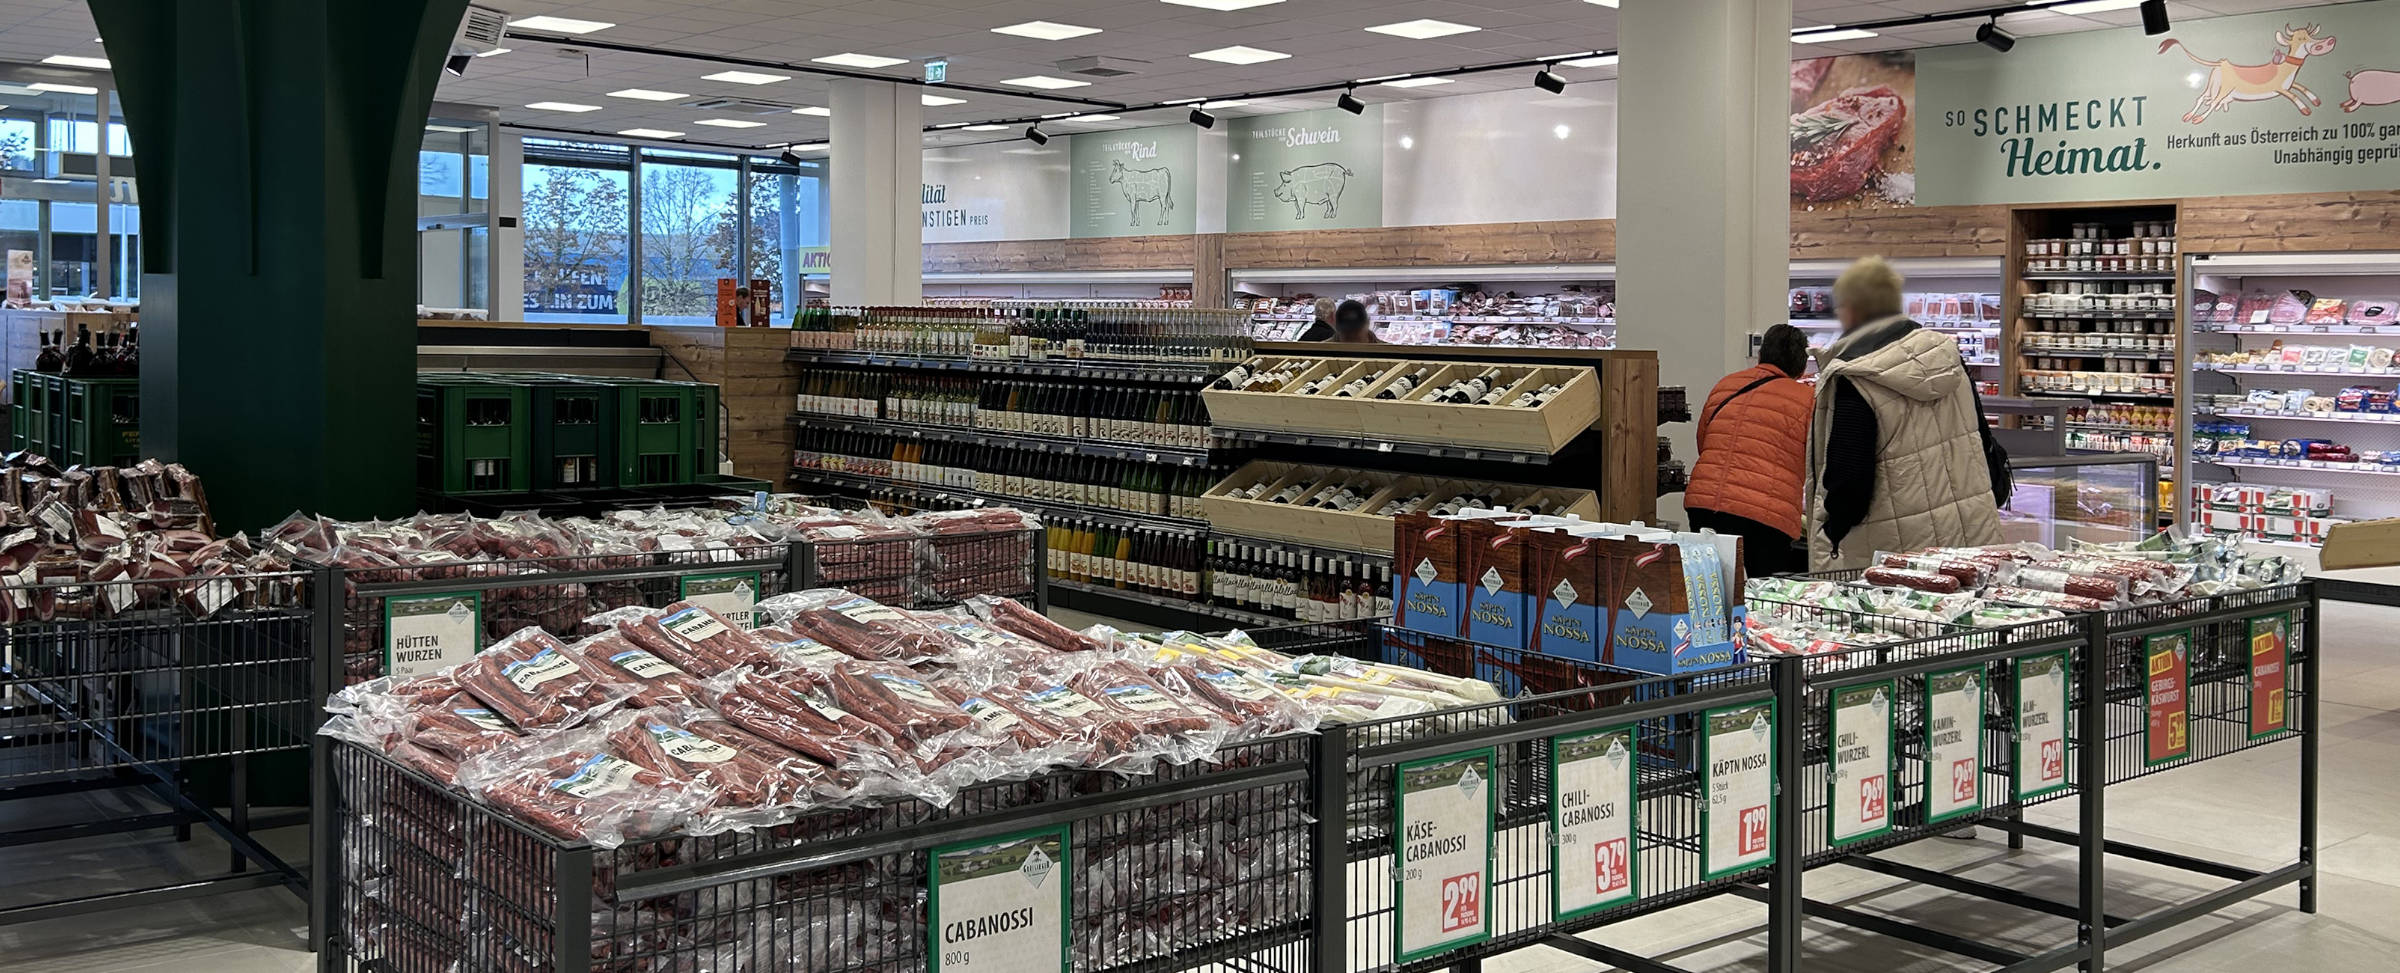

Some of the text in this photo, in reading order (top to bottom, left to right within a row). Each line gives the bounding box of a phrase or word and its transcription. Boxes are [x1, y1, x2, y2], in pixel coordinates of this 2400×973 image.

[1945, 96, 2148, 137] SO SCHMECKT
[1286, 126, 1341, 147] Schwein
[2167, 134, 2221, 149] Herkunft
[2223, 133, 2247, 146] aus
[2250, 127, 2318, 145] Österreich
[2322, 127, 2338, 141] zu
[2342, 122, 2375, 140] 100%
[1131, 140, 1158, 161] Rind
[2000, 136, 2162, 177] Heimat.
[2274, 145, 2353, 165] Unabhängig
[969, 214, 989, 226] PREIS
[576, 294, 614, 310] ZUM
[1407, 599, 1448, 617] NOSSA
[1472, 609, 1513, 628] NOSSA
[1543, 622, 1590, 642] NOSSA
[396, 634, 439, 650] HÜTTEN
[1615, 634, 1667, 653] NOSSA
[396, 648, 443, 664] WURZEN
[1700, 650, 1732, 664] NOSSA
[401, 666, 414, 675] Paar
[2022, 700, 2037, 713] ALM-
[1933, 715, 1957, 732] KAMIN-
[2022, 712, 2049, 729] WURZERL
[1837, 731, 1859, 749] CHILI-
[1933, 730, 1962, 748] WURZERL
[1837, 745, 1870, 765] WURZERL
[1712, 752, 1767, 778] KÄPTN NOSSA
[1561, 788, 1590, 809] CHILI-
[1561, 802, 1615, 828] CABANOSSI
[1406, 820, 1438, 843] KÄSE-
[1561, 834, 1572, 845] 300
[1406, 834, 1467, 863] CABANOSSI
[1405, 868, 1423, 881] 200 g
[945, 906, 1033, 944] CABANOSSI
[944, 950, 970, 967] 800 g
